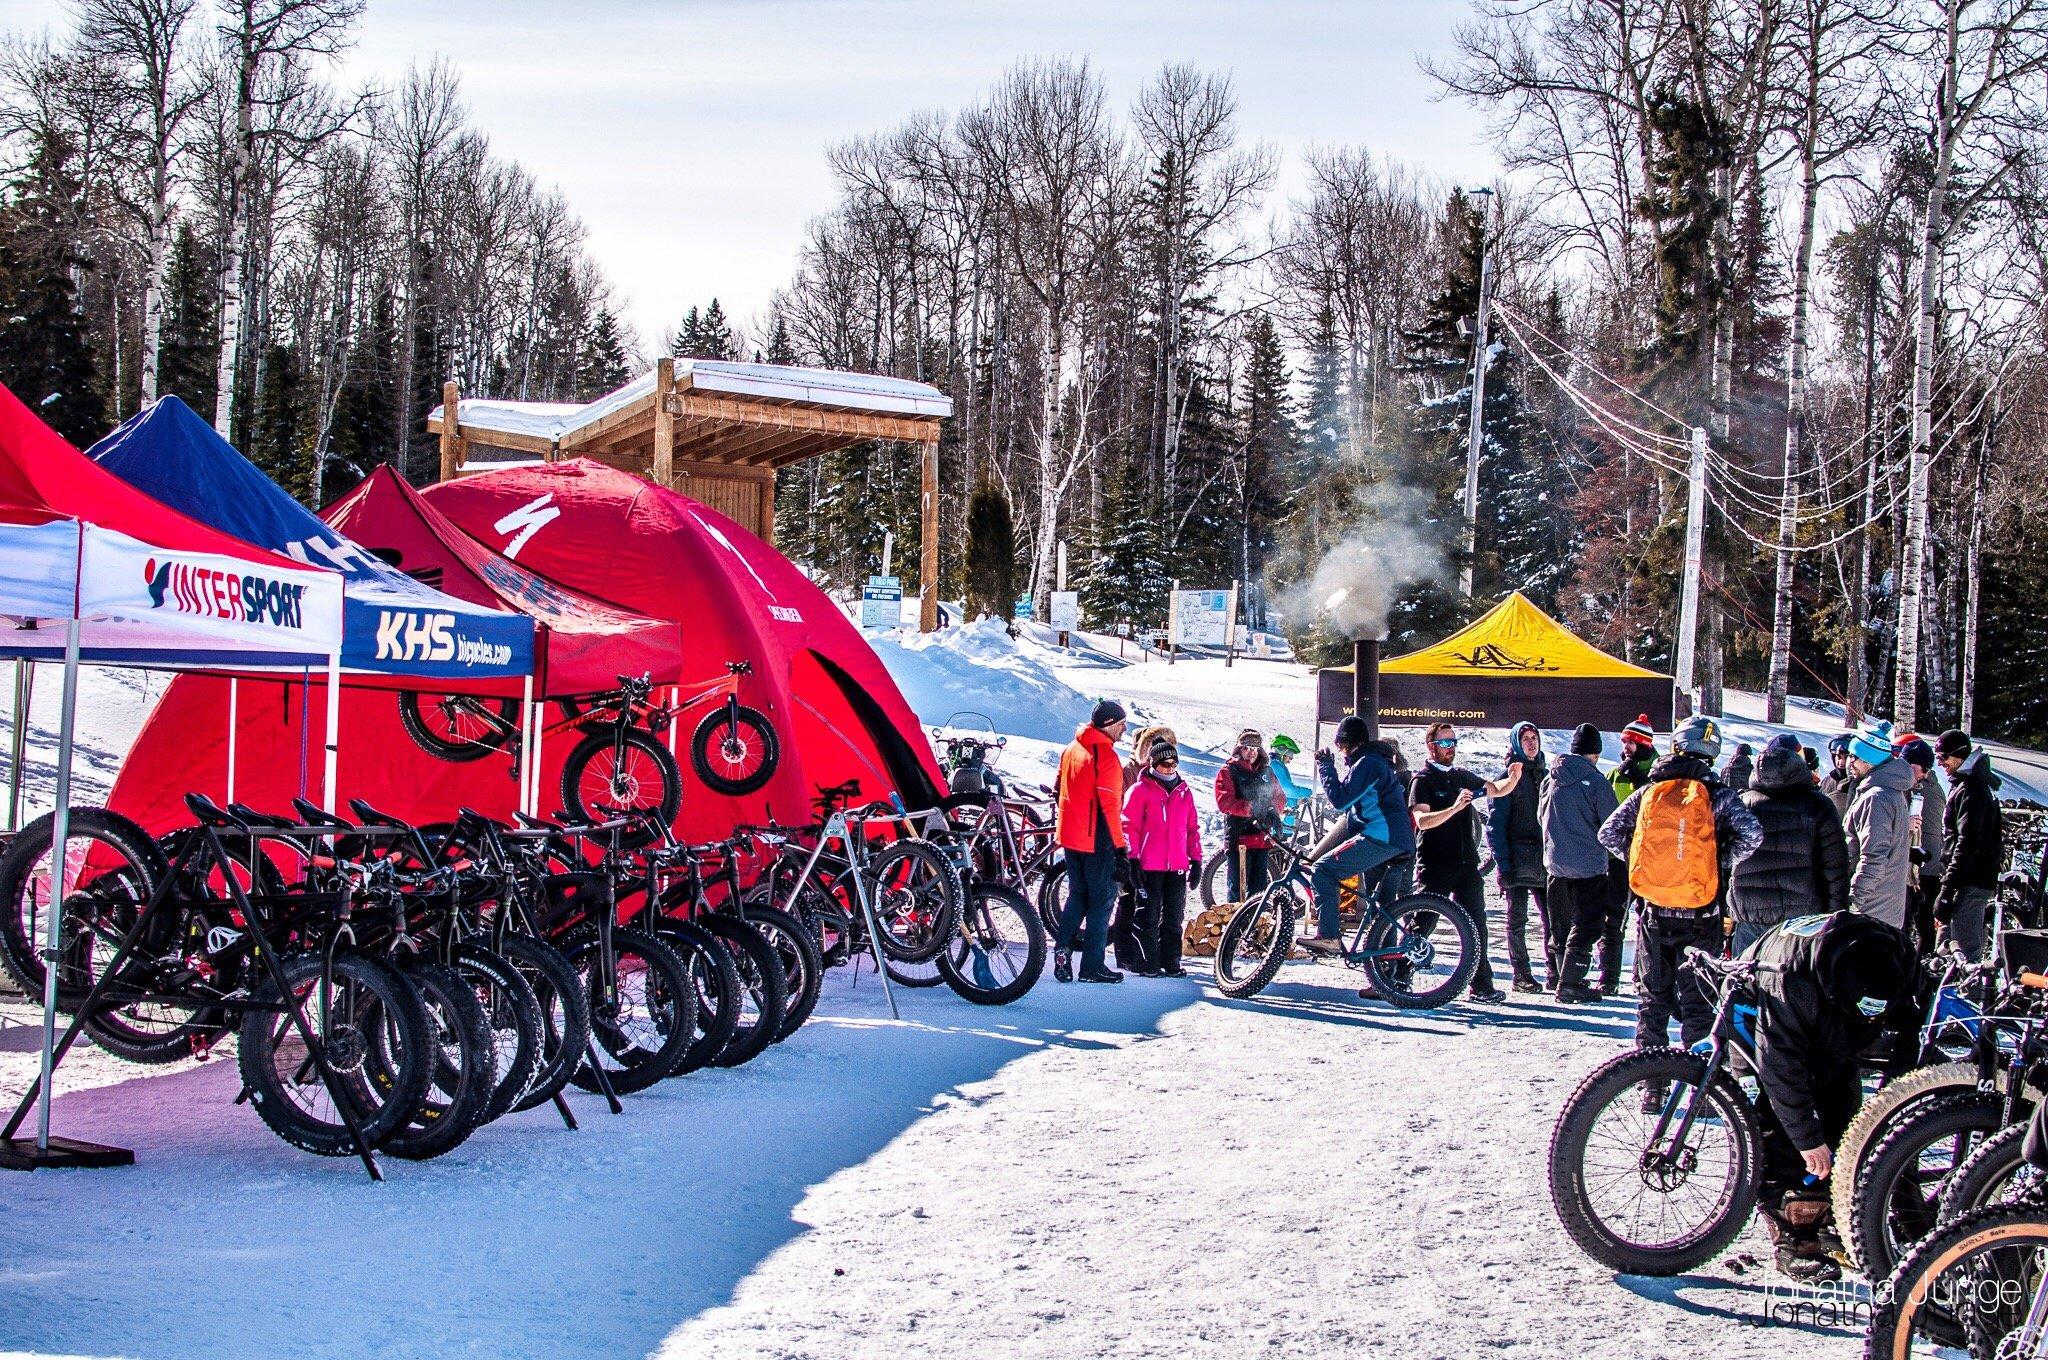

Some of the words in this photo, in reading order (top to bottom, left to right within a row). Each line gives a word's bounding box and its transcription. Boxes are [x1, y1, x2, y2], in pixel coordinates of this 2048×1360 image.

[173, 562, 303, 629] INTERSPORT
[375, 611, 456, 661] KHS
[457, 633, 512, 667] bicycles.com
[1342, 705, 1485, 719] wvelostfelicien.com
[1958, 1234, 1986, 1252] SURLY
